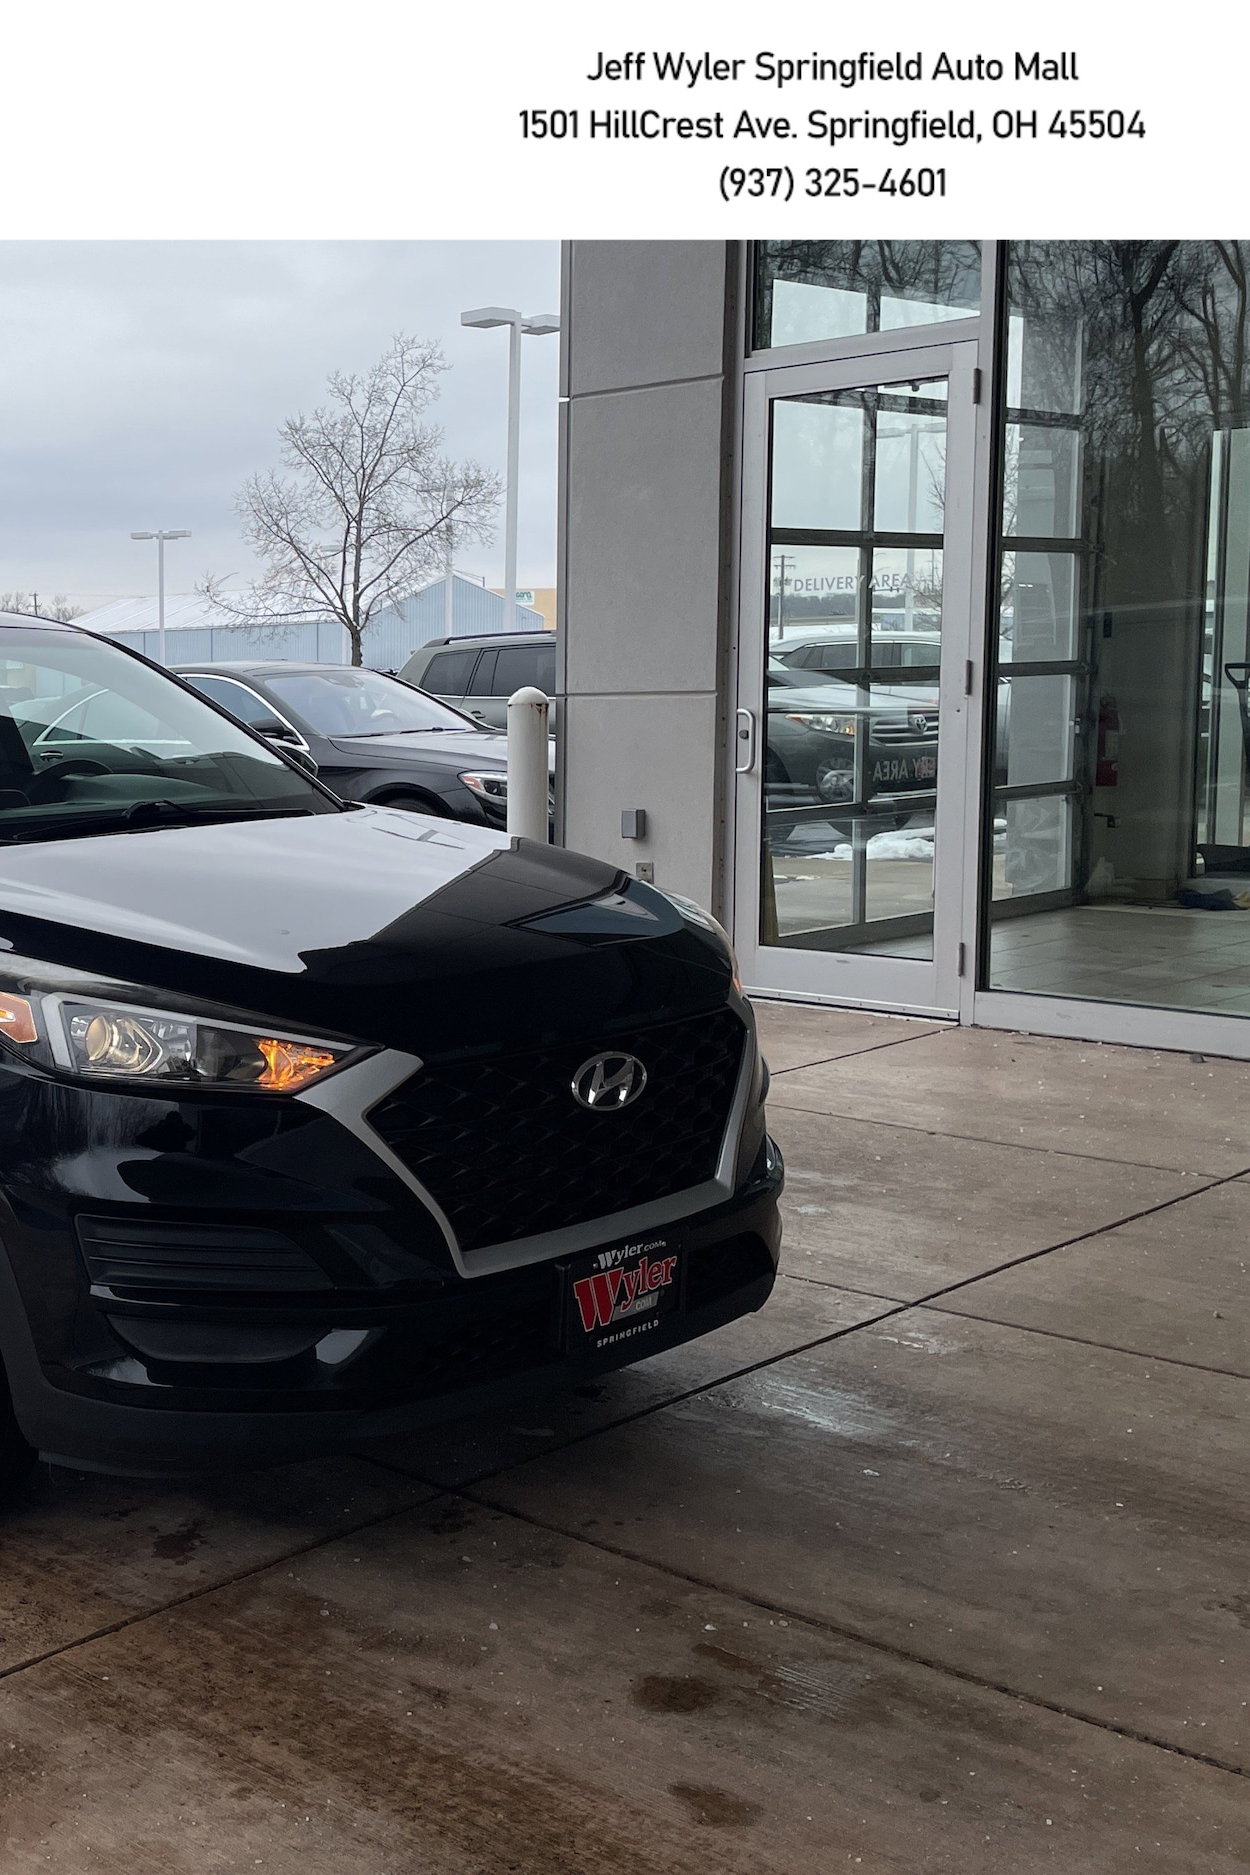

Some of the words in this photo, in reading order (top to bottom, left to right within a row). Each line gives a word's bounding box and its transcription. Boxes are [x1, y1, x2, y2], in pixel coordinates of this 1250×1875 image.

[793, 575, 865, 592] DELIVERY
[868, 573, 911, 589] AREA
[573, 1256, 678, 1333] Wyler
[596, 1319, 660, 1348] SPRINGFIELD
